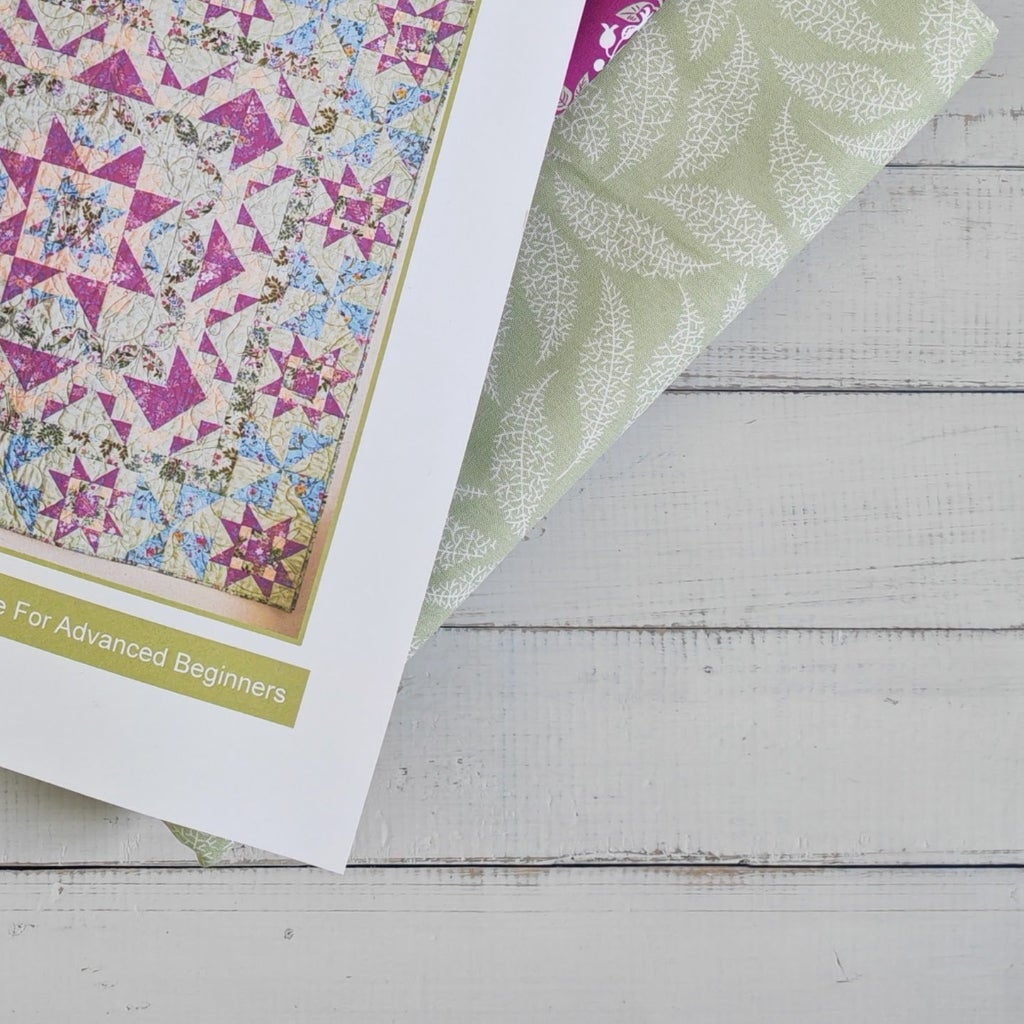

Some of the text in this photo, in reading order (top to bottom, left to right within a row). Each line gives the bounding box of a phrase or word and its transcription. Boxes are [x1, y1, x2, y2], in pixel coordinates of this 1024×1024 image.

[13, 601, 52, 630] For
[54, 616, 168, 668] Advanced
[174, 652, 287, 704] Beginners
